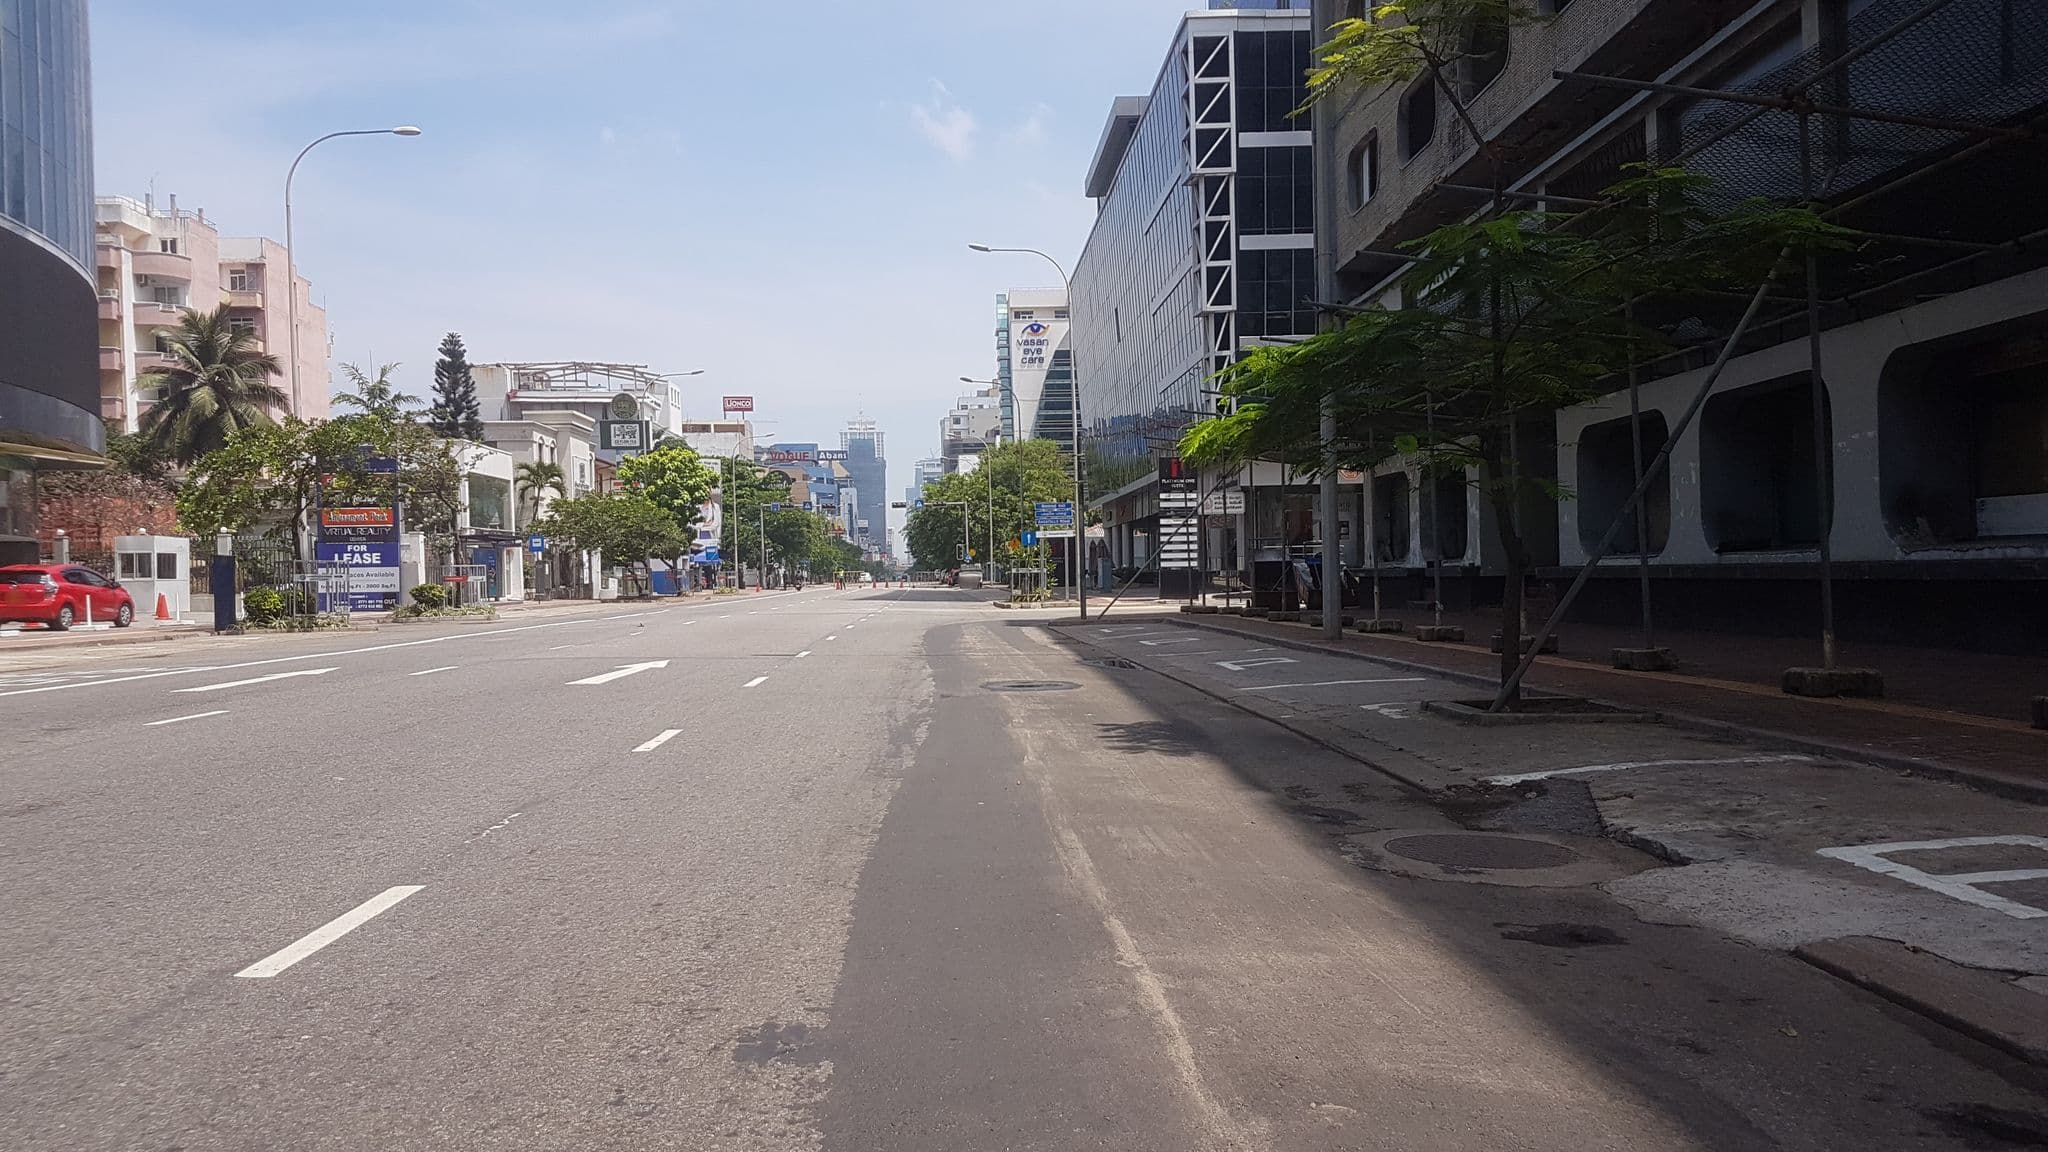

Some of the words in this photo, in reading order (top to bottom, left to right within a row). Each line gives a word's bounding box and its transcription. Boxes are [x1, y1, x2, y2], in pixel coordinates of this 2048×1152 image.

[1017, 338, 1049, 346] vasan
[1023, 347, 1042, 356] eye
[1021, 356, 1044, 364] care
[769, 451, 809, 460] VOGUE
[819, 451, 847, 459] Abans
[324, 528, 356, 536] VIRTUAL
[357, 527, 391, 536] REALITY
[334, 553, 382, 564] LEASE
